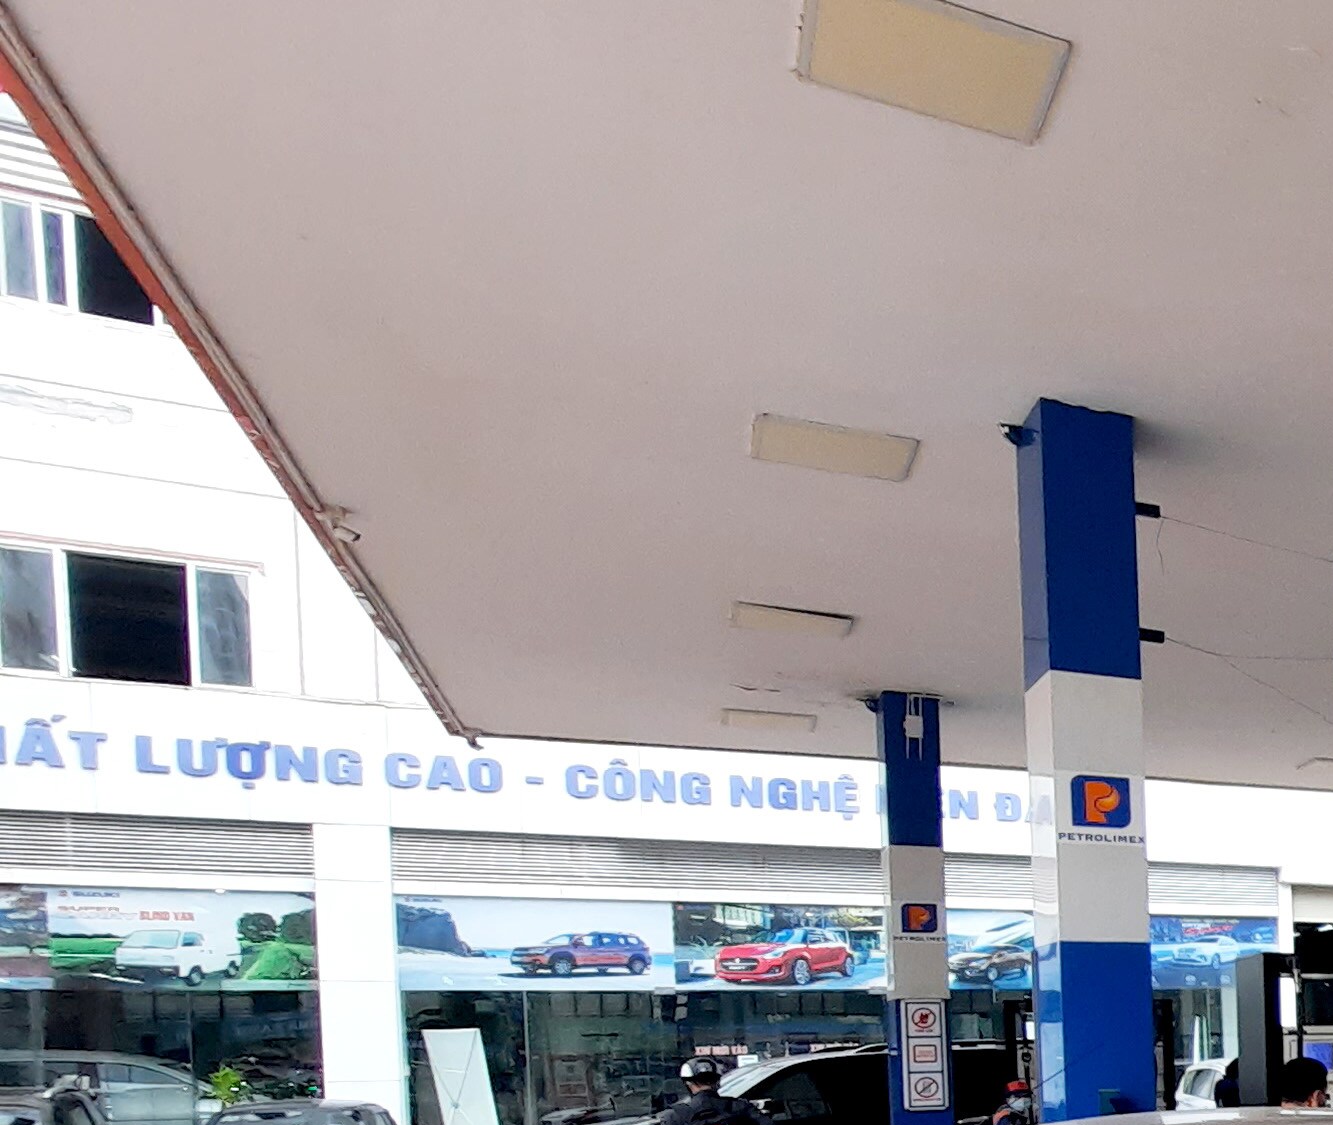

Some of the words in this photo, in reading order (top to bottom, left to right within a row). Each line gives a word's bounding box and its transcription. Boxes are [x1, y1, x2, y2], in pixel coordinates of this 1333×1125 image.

[0, 714, 108, 770] ẤT
[135, 734, 363, 790] LƯỢNG
[384, 752, 504, 794] CAO
[564, 758, 712, 806] CÔNG
[729, 774, 860, 821] NGHỆ
[1057, 831, 1146, 844] PETROLIMEX
